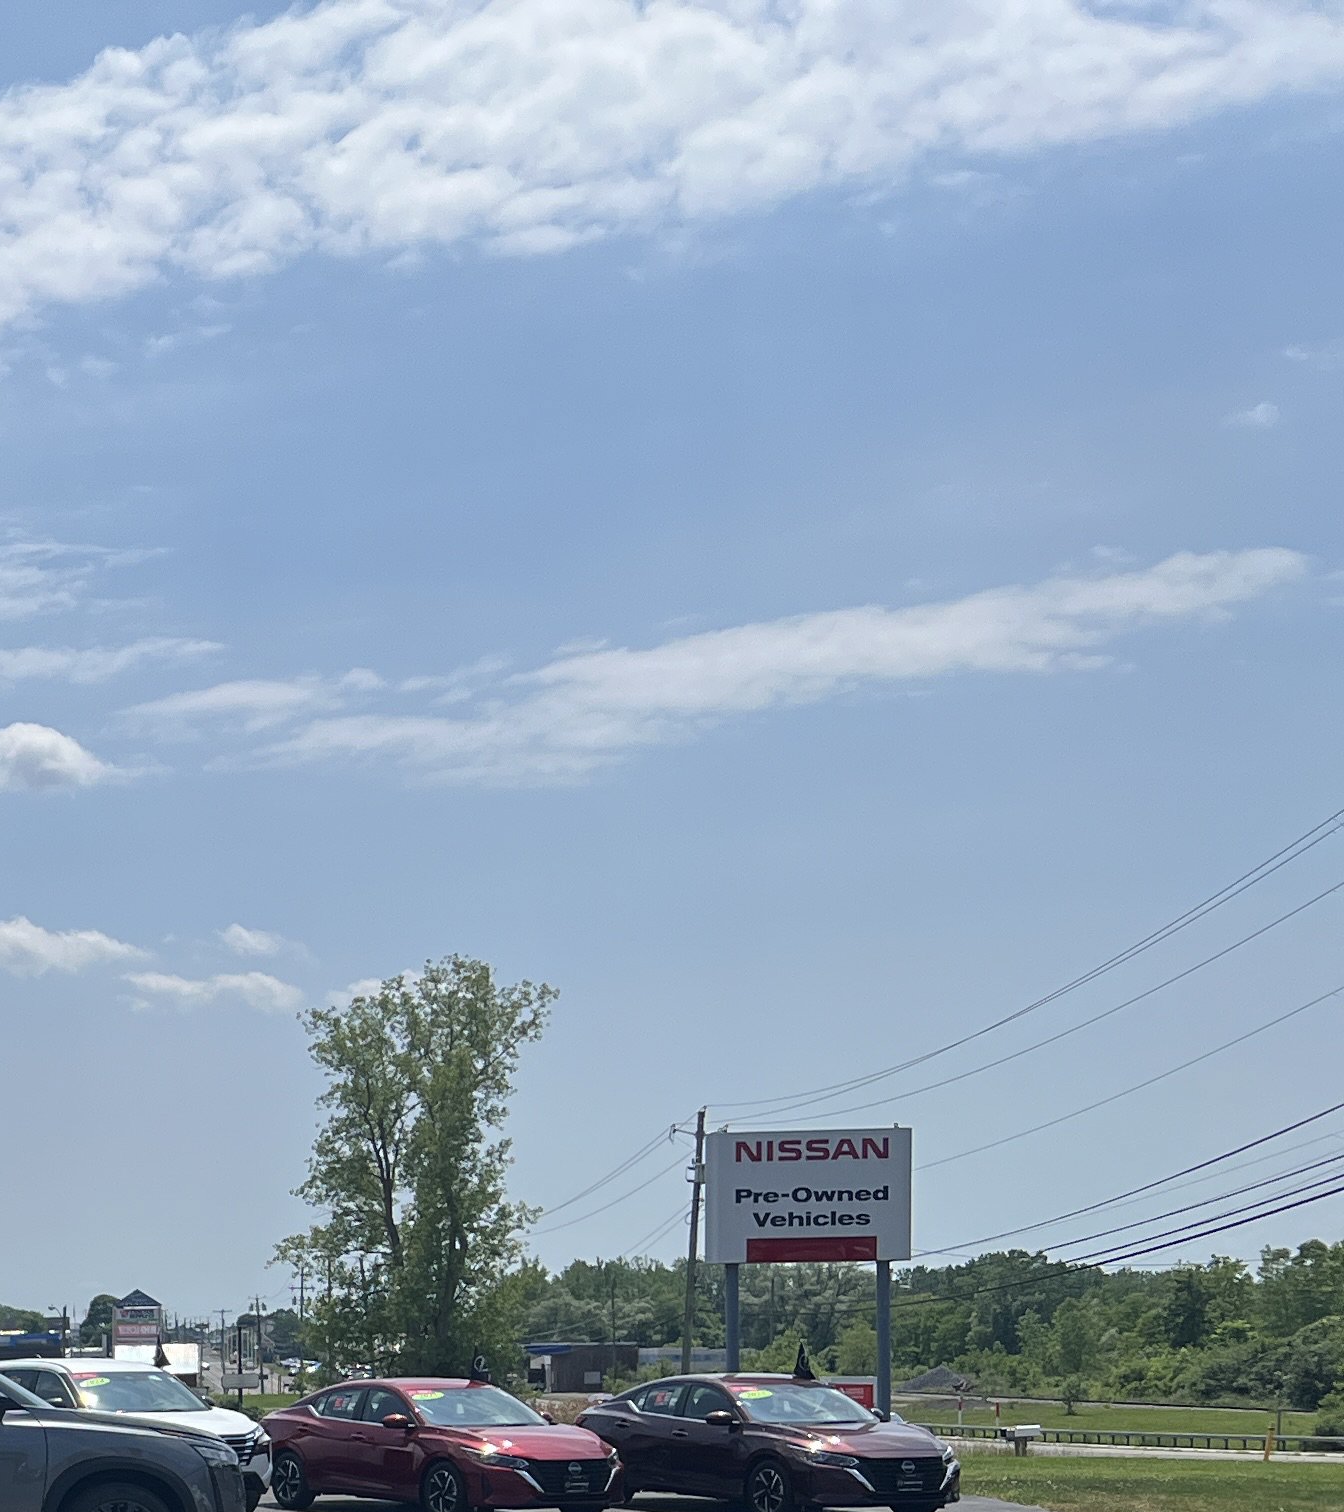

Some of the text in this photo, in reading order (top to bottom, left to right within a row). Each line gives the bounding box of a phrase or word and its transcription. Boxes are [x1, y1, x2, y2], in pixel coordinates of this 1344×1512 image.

[735, 1137, 889, 1163] NISSAN
[735, 1185, 889, 1204] Pre-Owned
[752, 1210, 871, 1227] Vehicles
